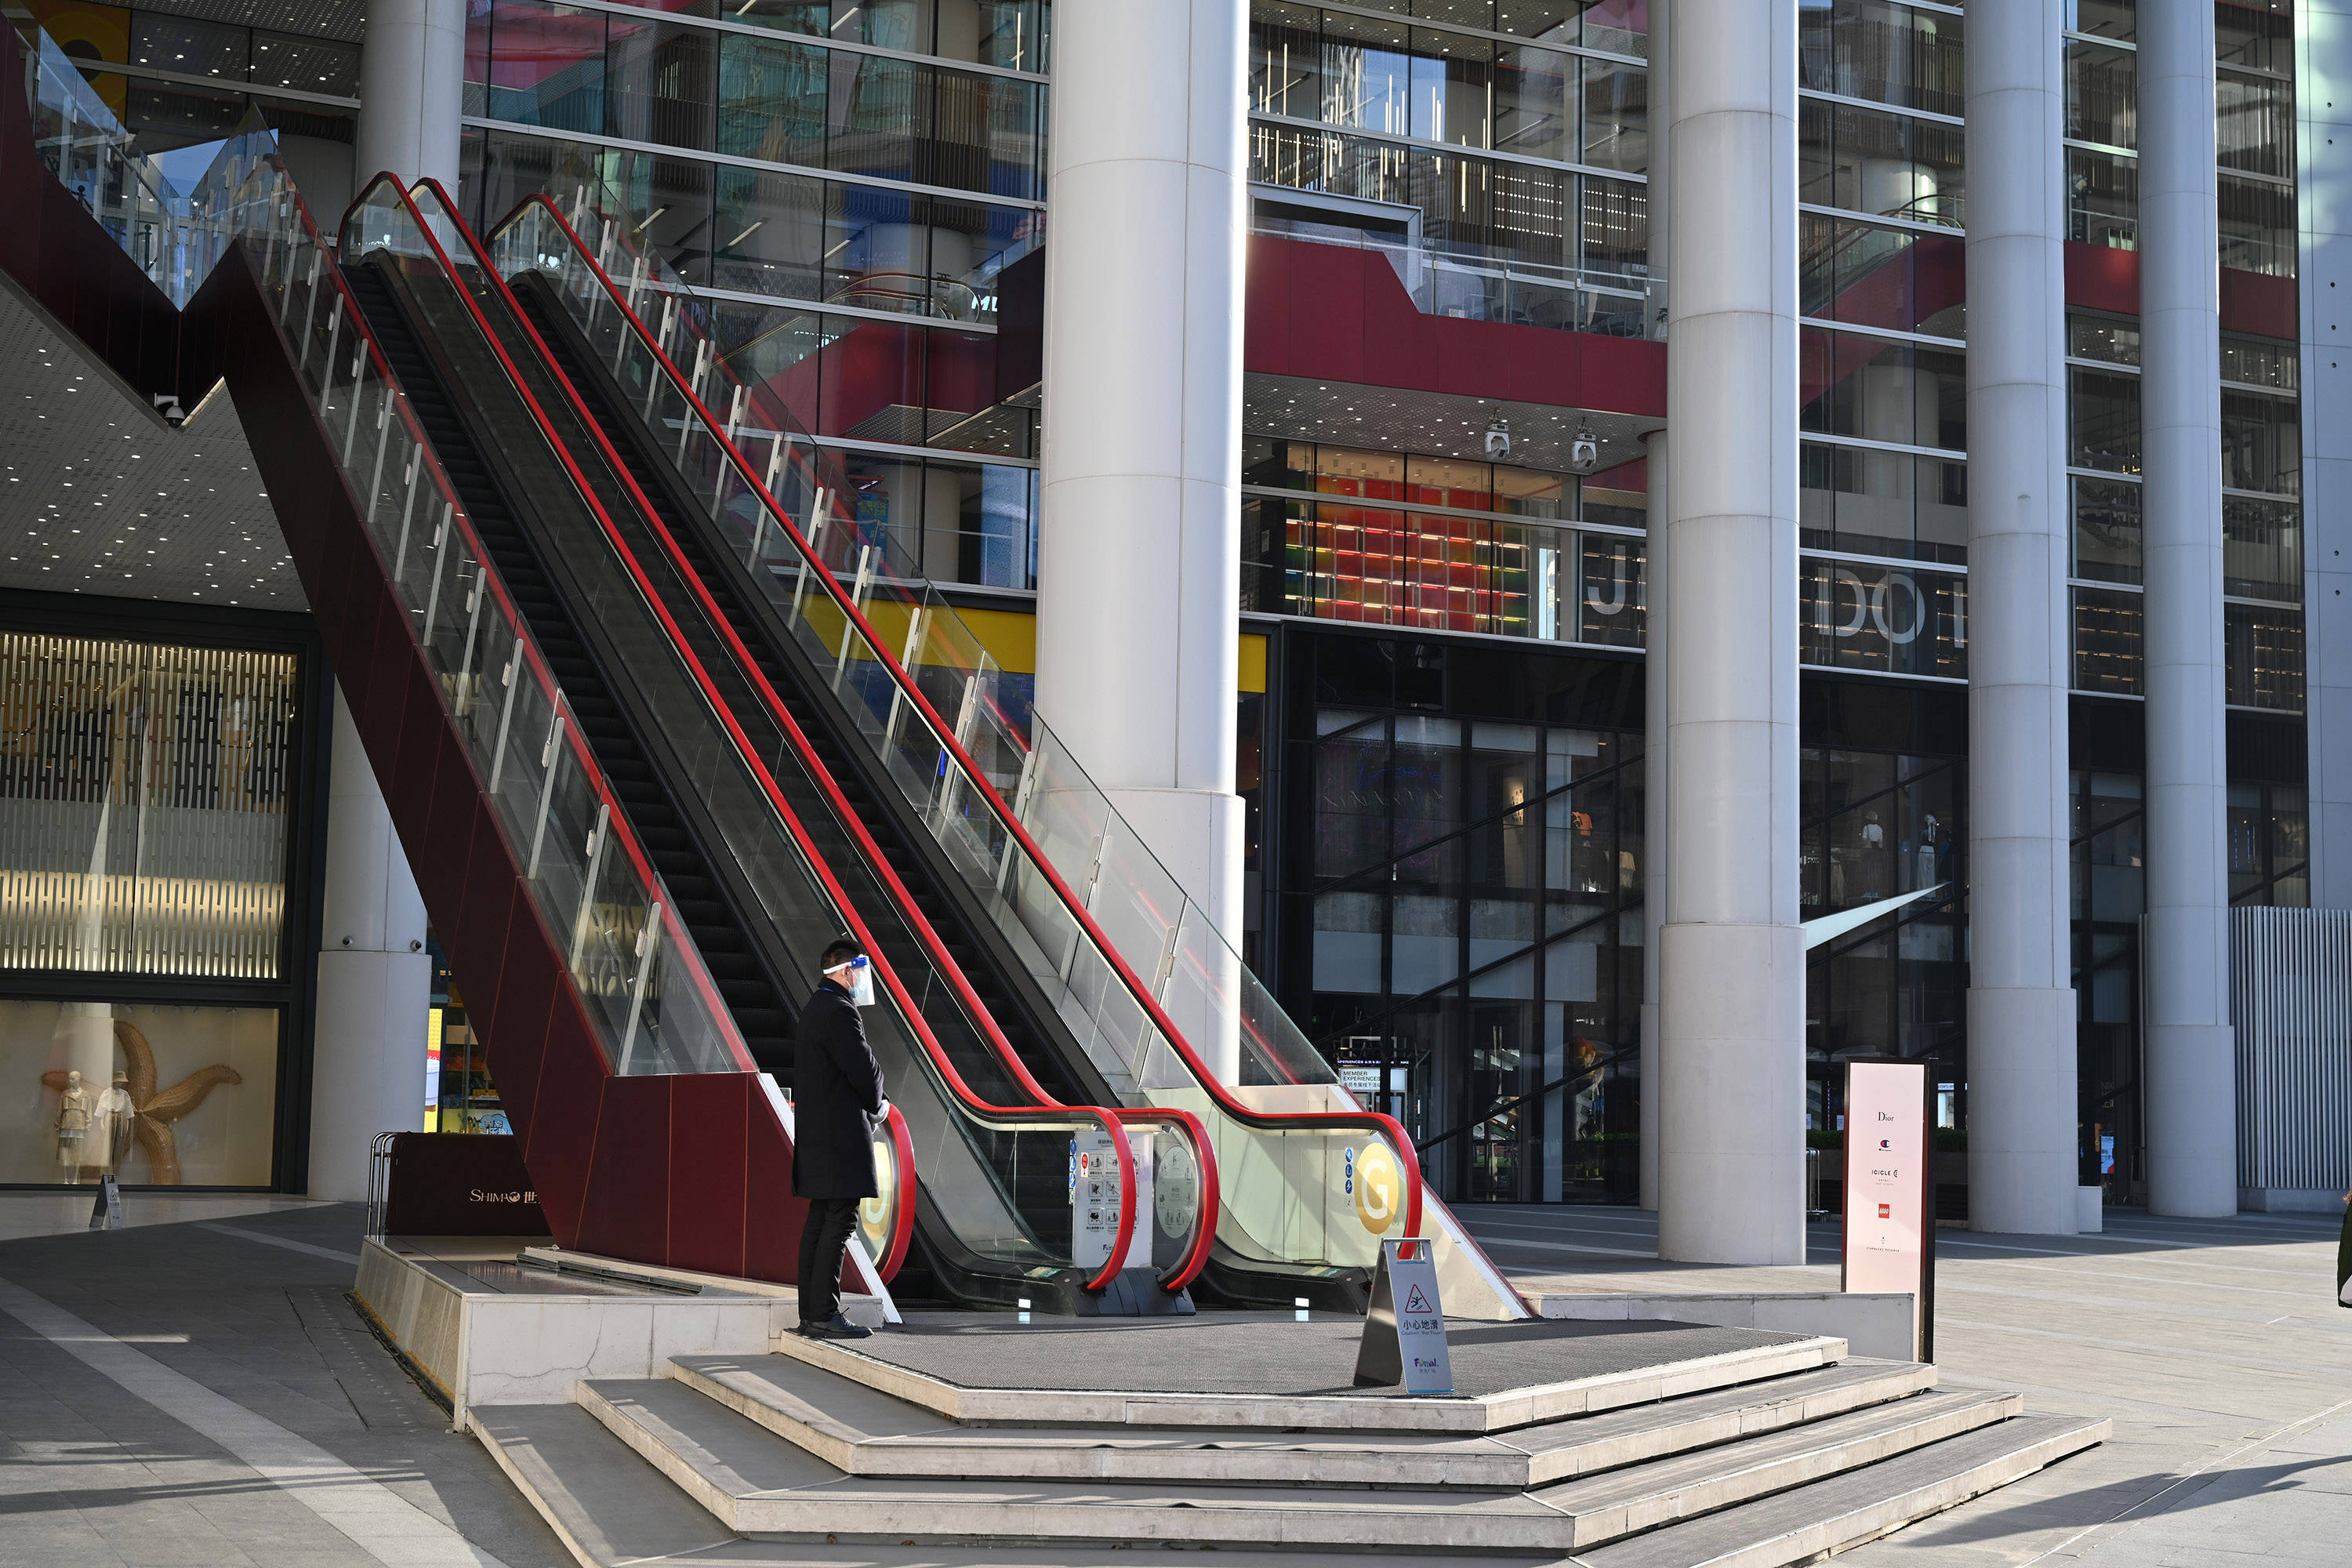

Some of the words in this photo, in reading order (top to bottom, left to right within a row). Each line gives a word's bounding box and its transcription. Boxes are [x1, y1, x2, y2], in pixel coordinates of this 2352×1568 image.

[1817, 566, 1926, 644] DO
[1878, 1111, 1894, 1121] Dior
[1361, 1158, 1388, 1220] G
[524, 1191, 540, 1203] 世
[1403, 1319, 1439, 1330] 小心地滑
